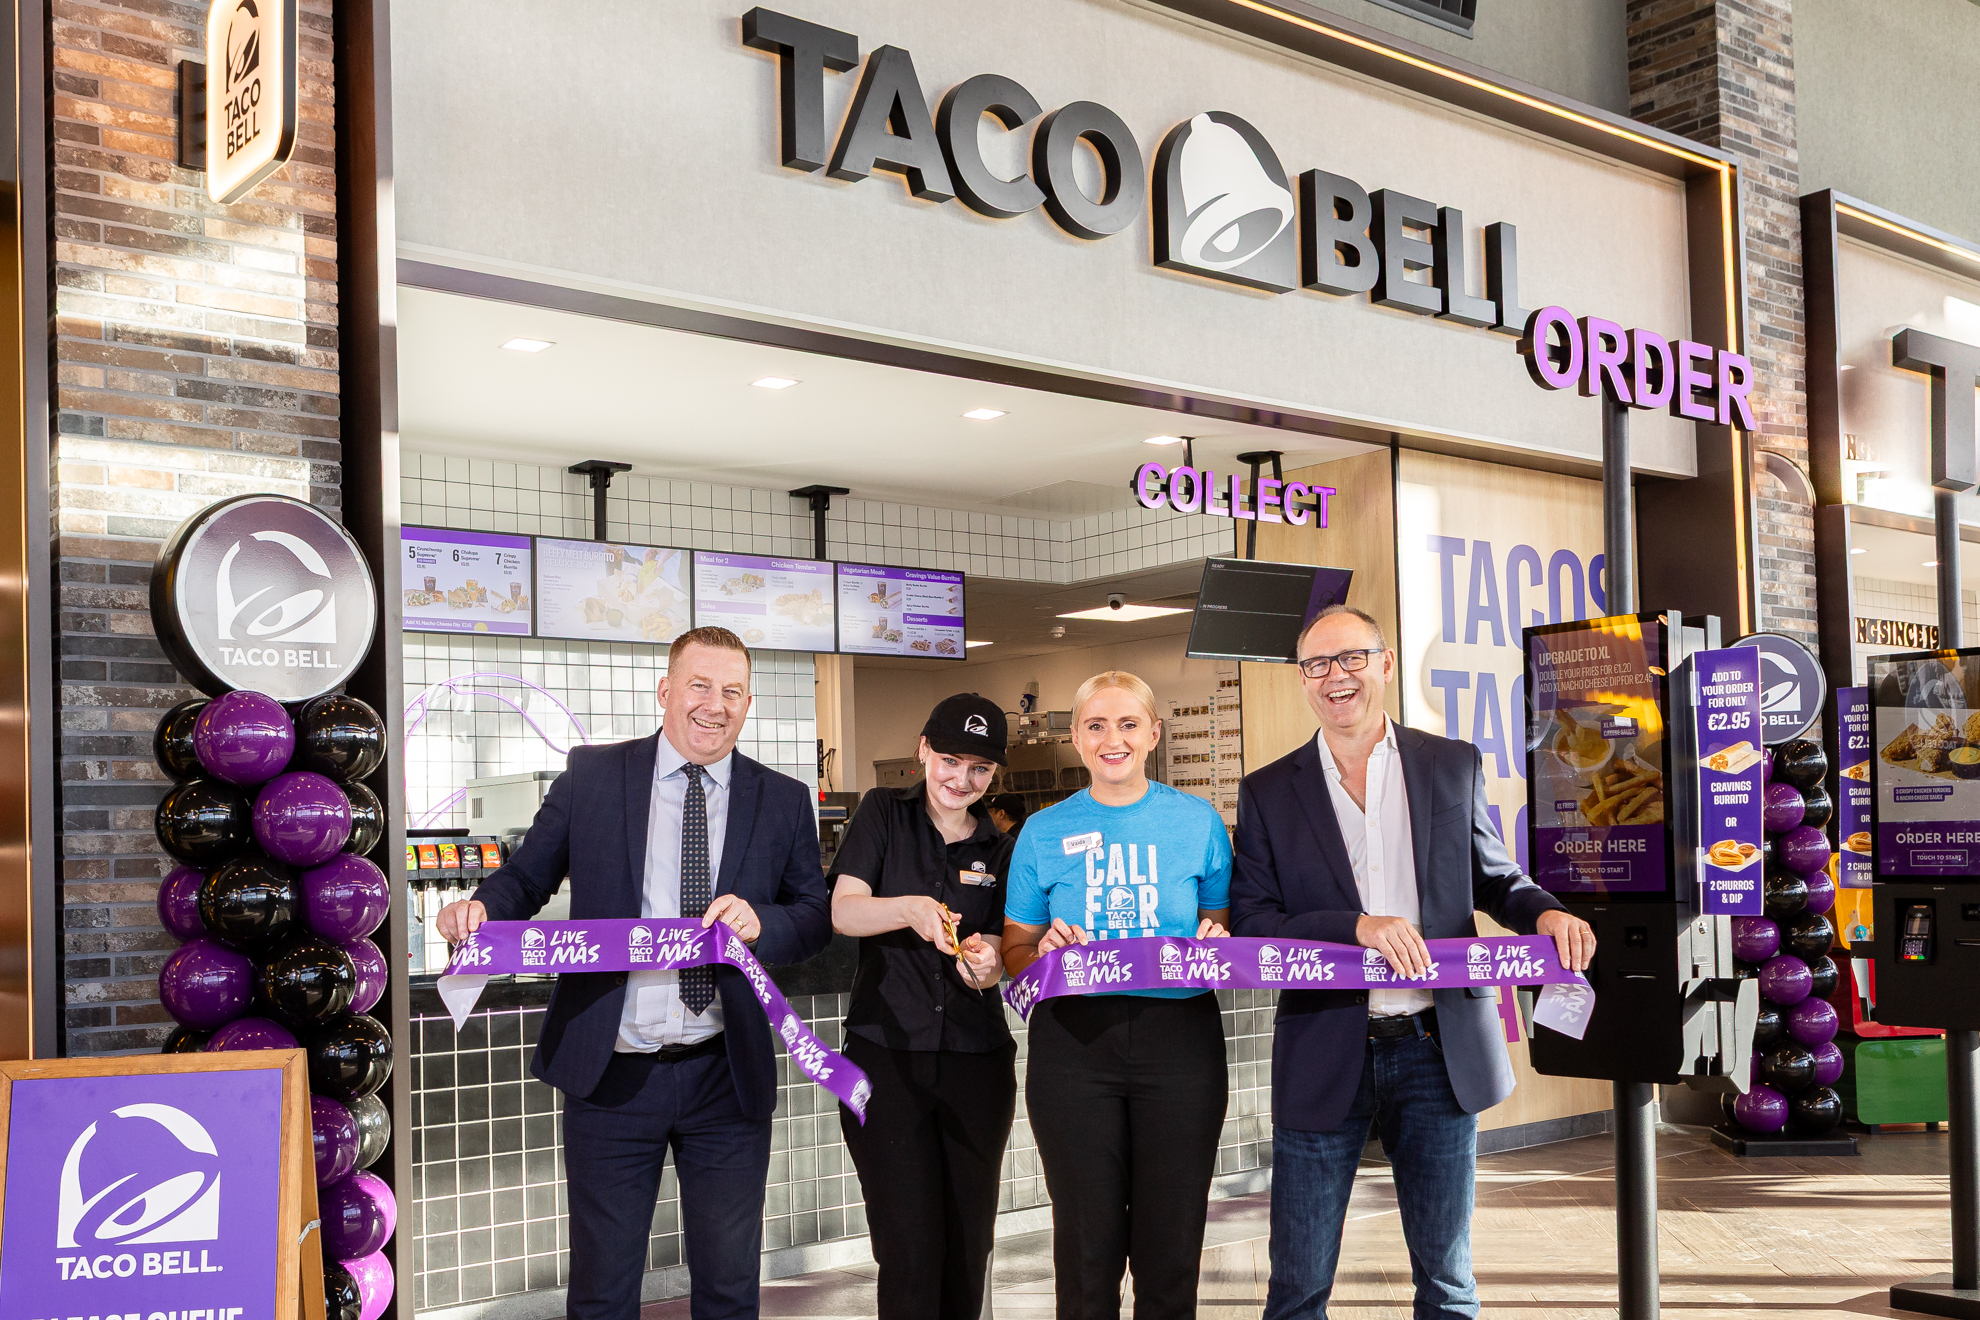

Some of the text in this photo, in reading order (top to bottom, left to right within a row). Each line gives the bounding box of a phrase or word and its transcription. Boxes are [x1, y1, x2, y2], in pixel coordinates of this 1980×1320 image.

[224, 77, 262, 131] TACO
[225, 111, 261, 161] BELL
[742, 6, 1532, 338] TACO BELL
[1524, 305, 1757, 431] ORDER
[1134, 462, 1337, 529] COLLECT
[408, 546, 416, 559] 5
[452, 549, 460, 562] 6
[584, 550, 615, 562] BURRITO
[495, 552, 502, 565] 7
[716, 556, 724, 564] for
[544, 558, 594, 570] DELUXE BOX
[771, 562, 816, 571] Chicken Tenders
[842, 566, 870, 574] Vegetarian
[906, 572, 926, 580] Cravings
[700, 602, 716, 610] Sides
[218, 647, 280, 667] TACO
[1538, 646, 1610, 666] UPGRADE TO XL
[1539, 662, 1632, 682] DOUBLE YOUR FRIES FOR €1.20
[1712, 670, 1741, 682] ADD TO
[1539, 673, 1654, 694] ADD XL NACHO CHEESE DIP FOR €2.45
[1702, 682, 1754, 696] YOUR ORDER
[1708, 696, 1746, 708] FOR ONLY
[1851, 704, 1864, 712] ADD
[1708, 712, 1750, 730] €2.95
[1844, 714, 1861, 722] YOUR
[1848, 724, 1861, 732] FOR
[1710, 781, 1752, 792] CRAVINGS
[1714, 794, 1749, 805] BURRITO
[1725, 817, 1737, 828] OR
[1896, 832, 1980, 844] ORDER HERE
[1554, 839, 1646, 854] ORDER HERE
[1085, 844, 1158, 886] CALI
[1852, 862, 1872, 870] CHUR
[1710, 880, 1754, 890] 2 CHURROS
[1722, 893, 1743, 903] & DIP
[1106, 912, 1136, 920] TACO
[1108, 920, 1135, 930] BELL
[521, 950, 546, 958] TACO
[628, 948, 653, 956] TACO
[523, 957, 546, 966] BELL
[630, 955, 652, 963] BELL
[1160, 965, 1183, 973] TACO
[1258, 965, 1283, 974] TACO
[1362, 966, 1386, 975] TACO
[1064, 971, 1085, 979] TACO
[1161, 972, 1183, 980] BELL
[1261, 974, 1283, 982] BELL
[1364, 974, 1387, 982] BELL
[1469, 972, 1492, 980] BELL
[1067, 978, 1086, 987] BELL
[56, 1254, 137, 1280] TACO
